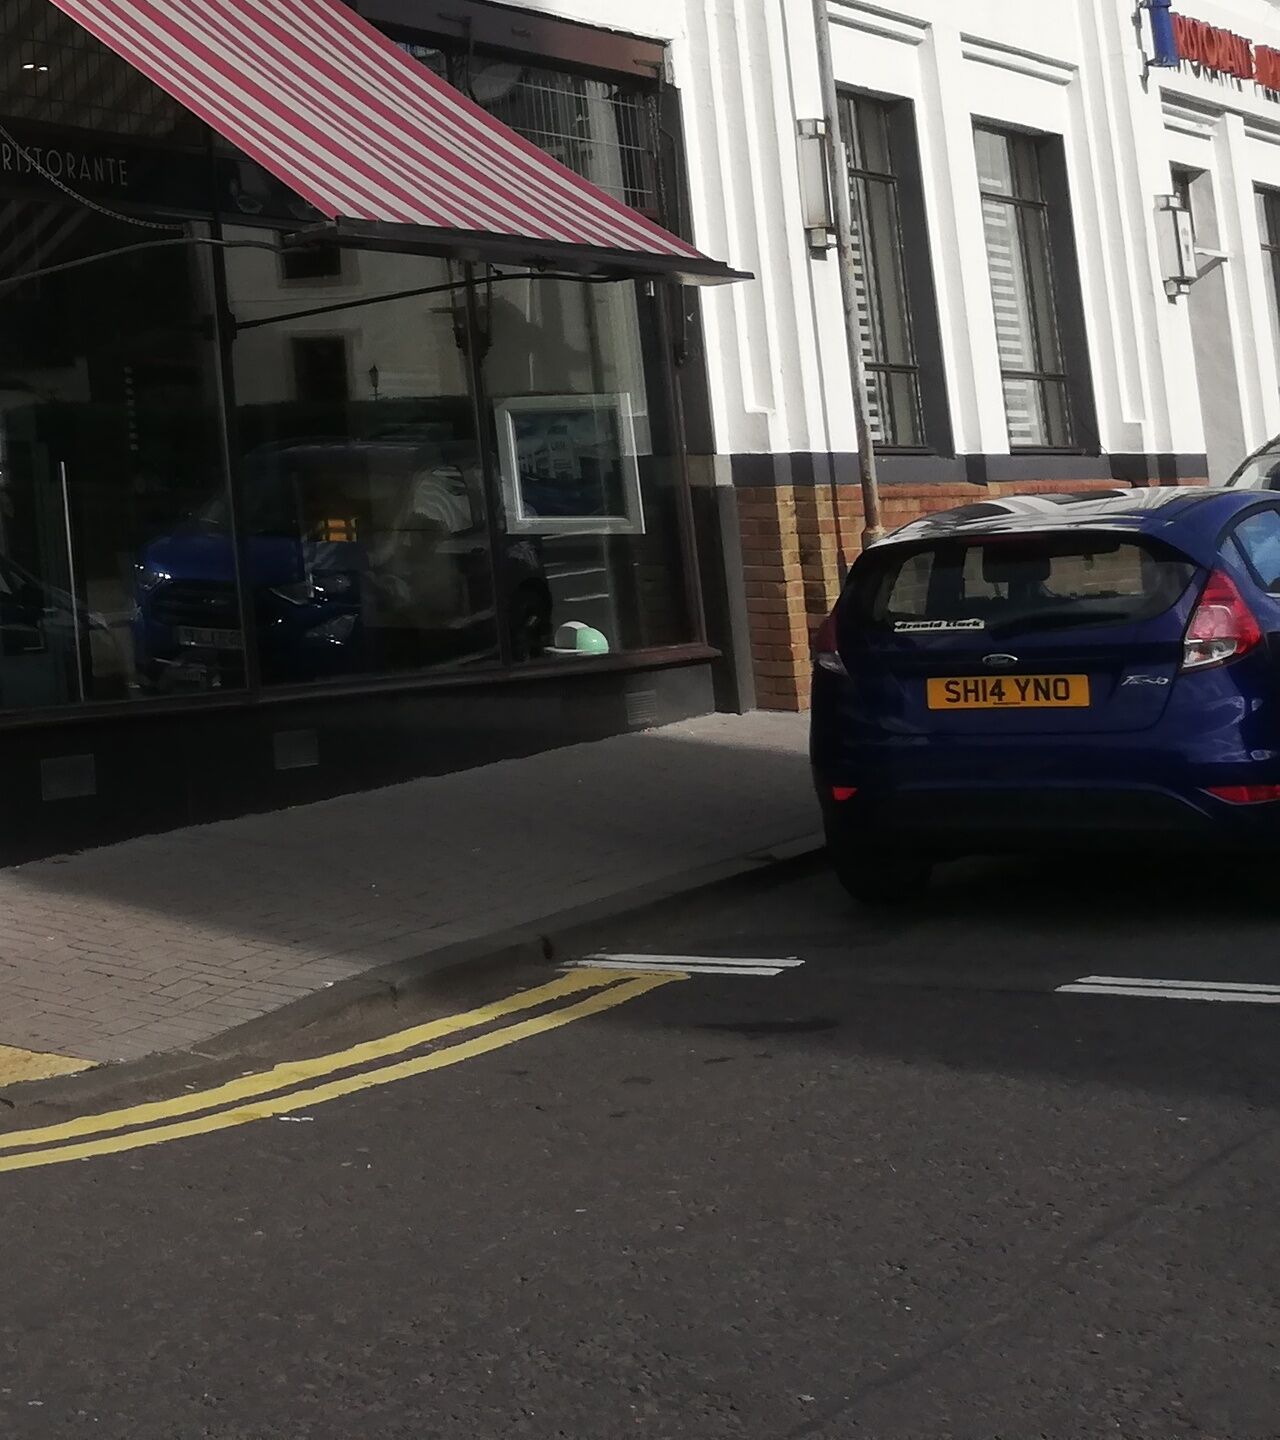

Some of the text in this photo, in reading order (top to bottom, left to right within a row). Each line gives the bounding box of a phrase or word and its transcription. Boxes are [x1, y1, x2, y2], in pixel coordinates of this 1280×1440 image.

[1, 142, 128, 187] RISTORANTE
[944, 677, 1070, 704] SH14 YNO
